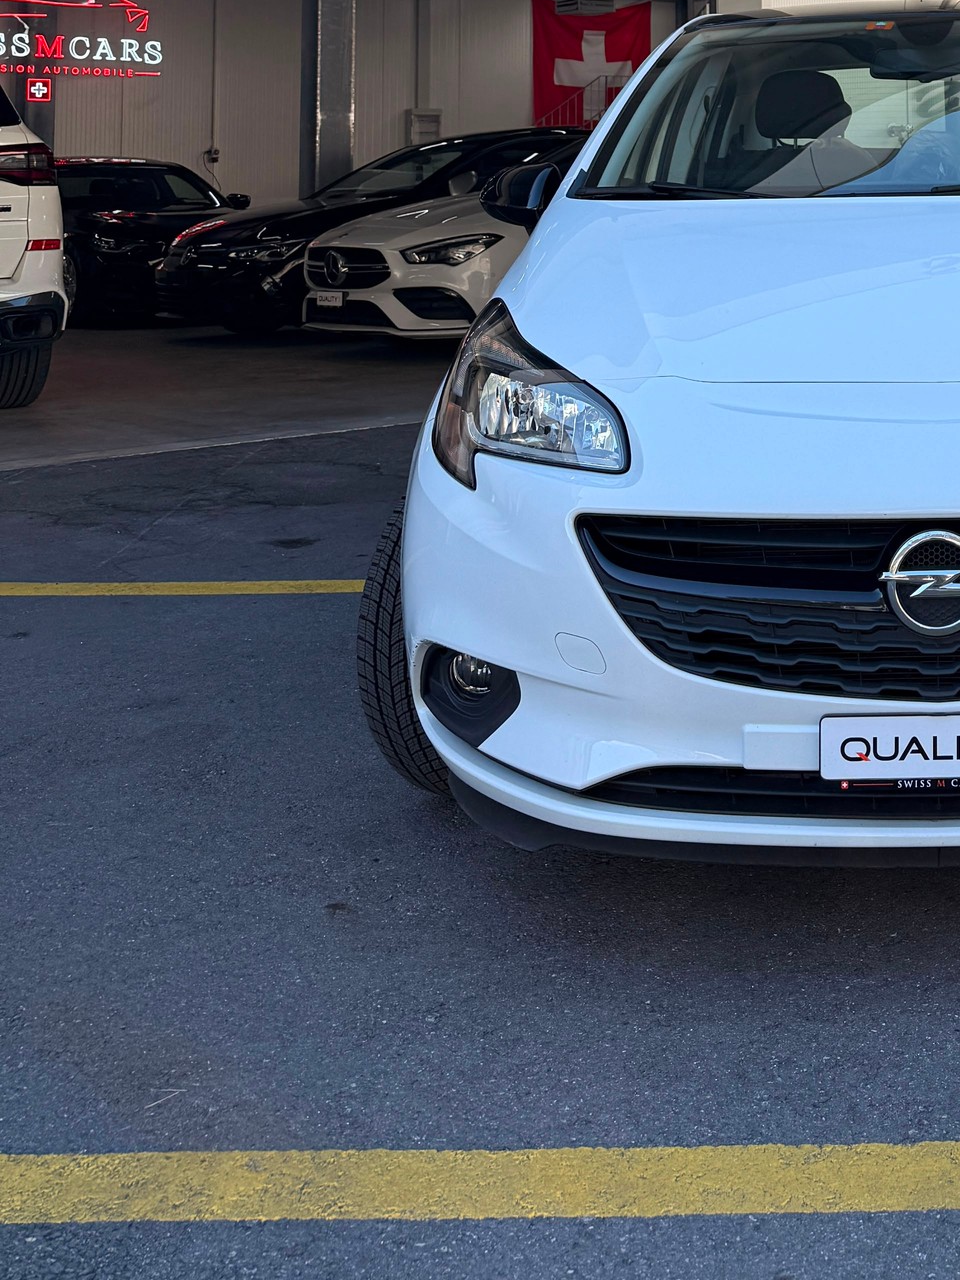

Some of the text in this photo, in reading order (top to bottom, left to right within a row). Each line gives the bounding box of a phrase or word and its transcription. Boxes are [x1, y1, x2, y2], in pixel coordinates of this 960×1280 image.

[43, 66, 134, 78] AUTOMOBILE
[897, 779, 932, 789] SWISS
[936, 780, 946, 788] M
